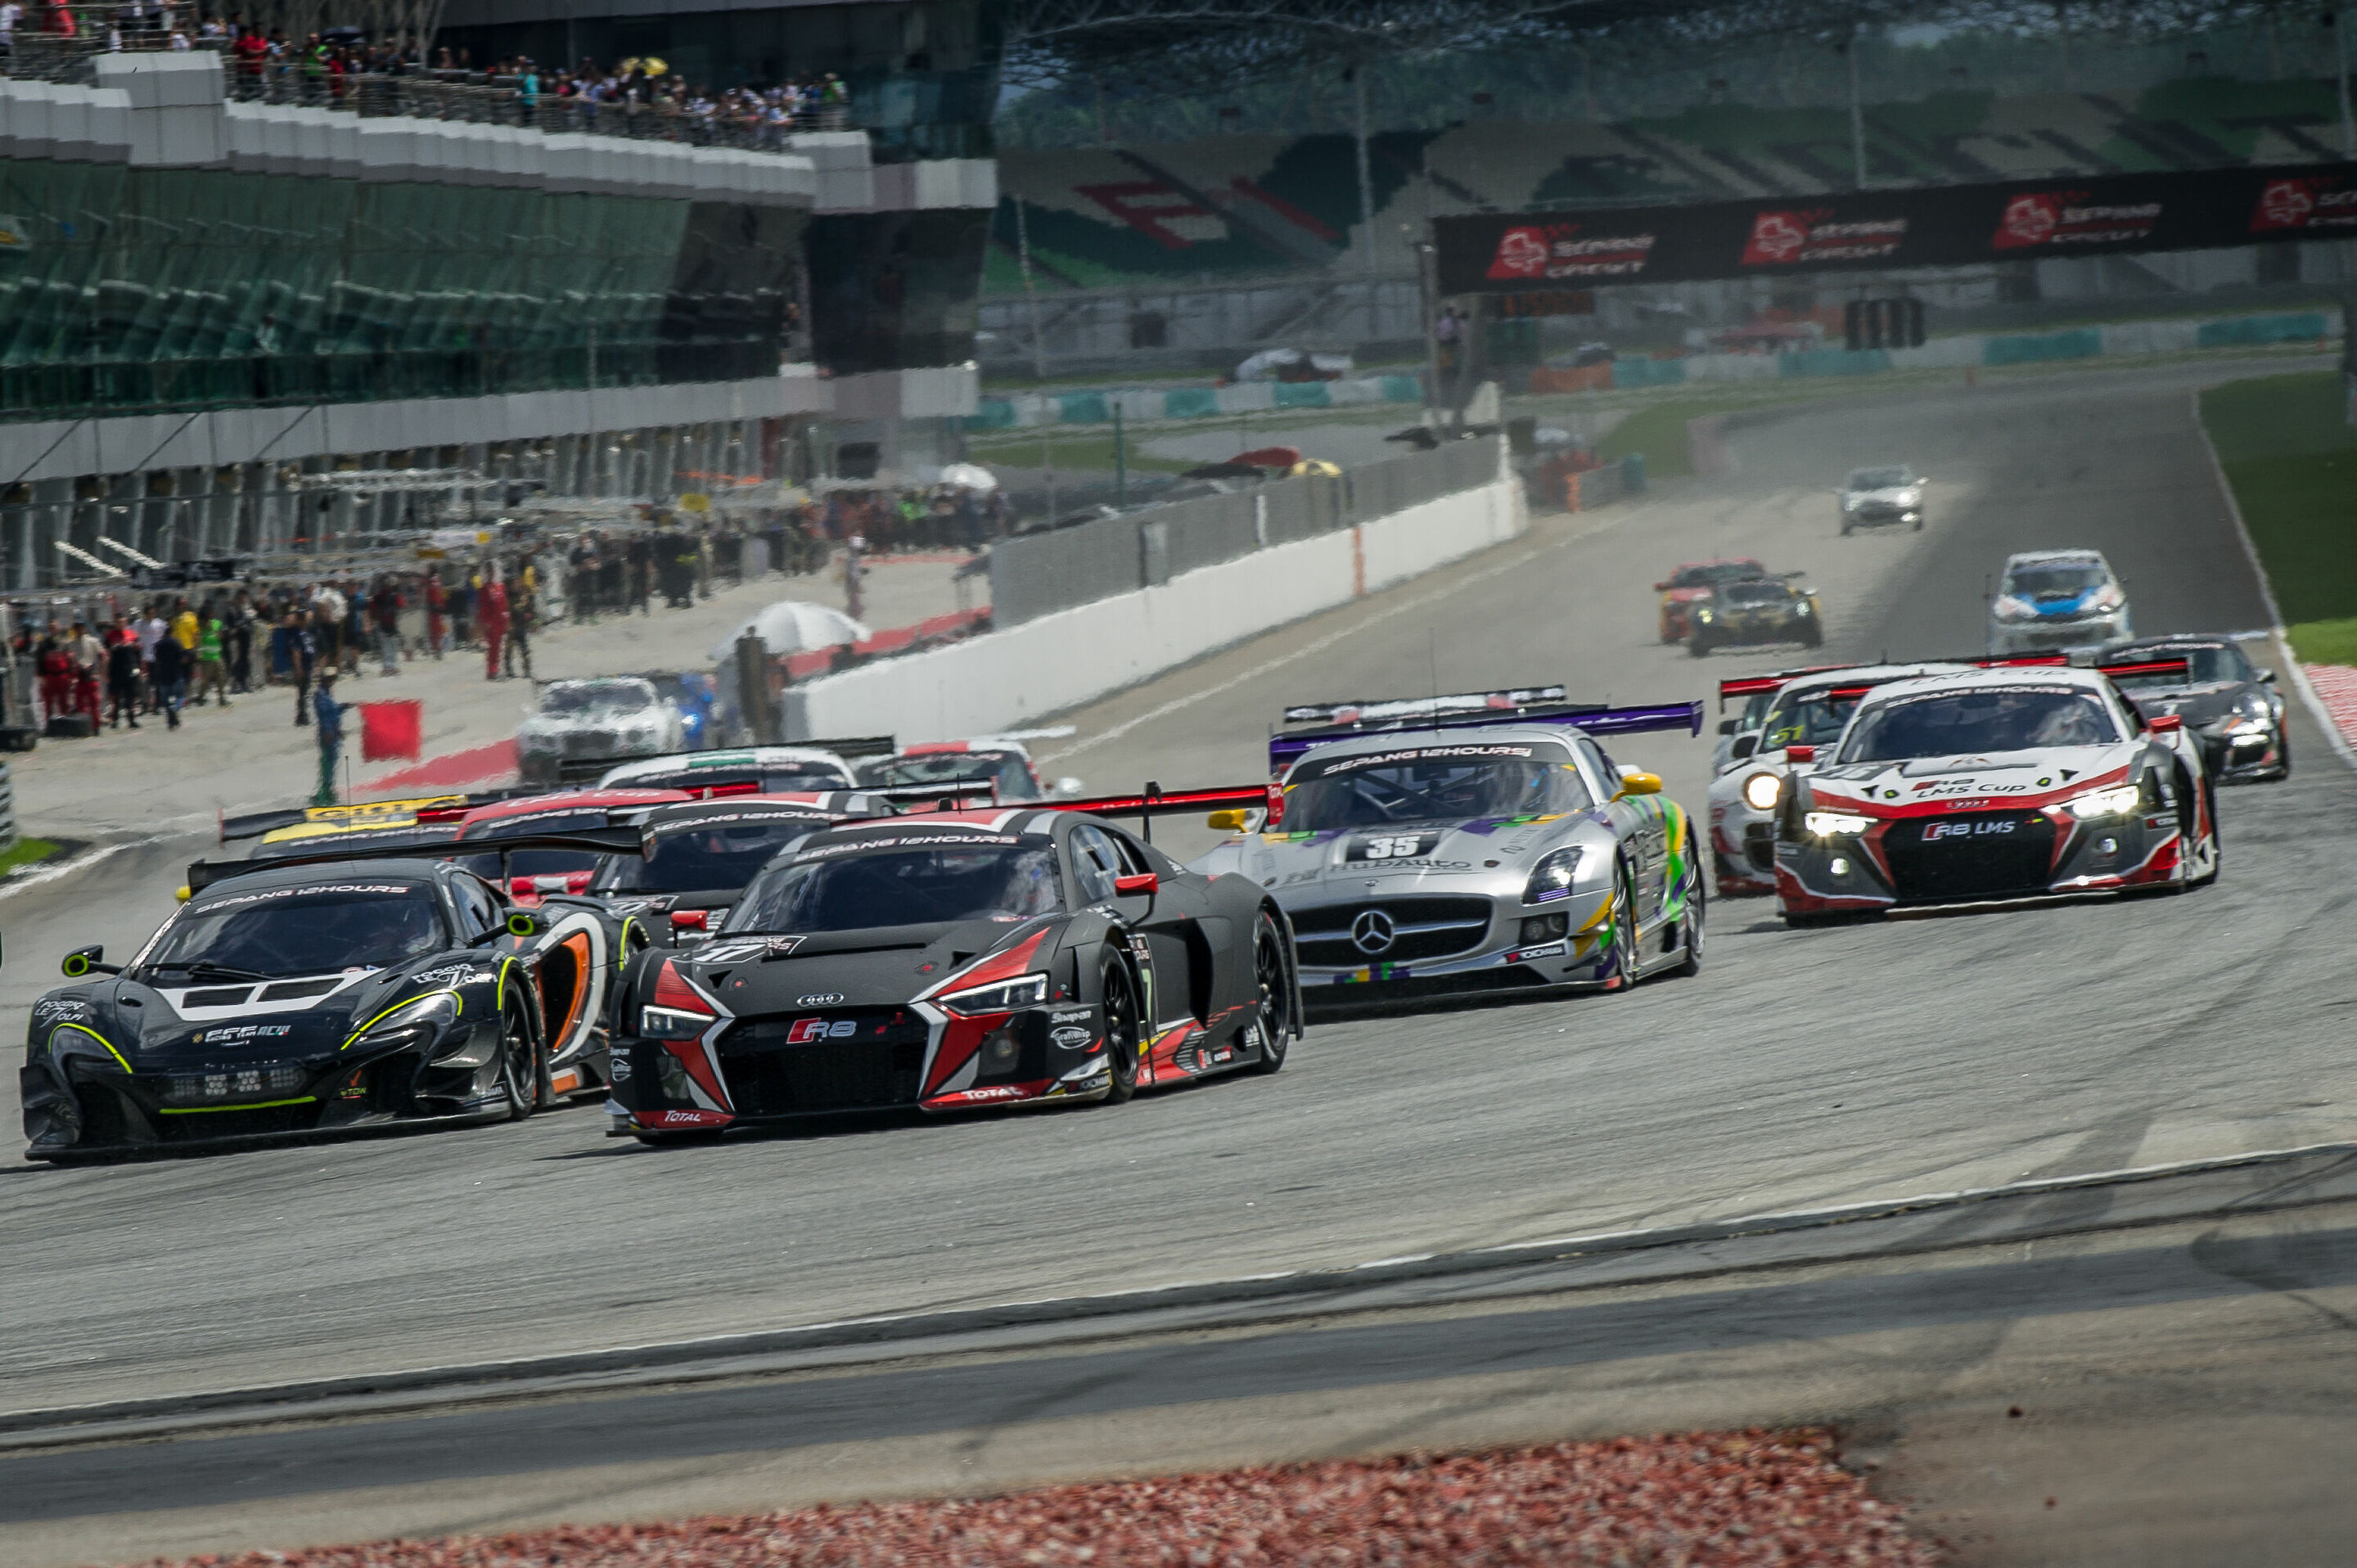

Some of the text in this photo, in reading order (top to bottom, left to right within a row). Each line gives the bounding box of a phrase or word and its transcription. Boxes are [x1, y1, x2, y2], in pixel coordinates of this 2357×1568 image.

[1323, 746, 1532, 776] SEPANG 12HOURS
[1917, 783, 2027, 799] LMS Cup
[1974, 821, 2017, 835] LMS
[793, 835, 1020, 862] SEPANG 12HOURS
[1366, 836, 1422, 860] 35
[195, 885, 411, 914] SEPANG 12HOURS
[798, 1020, 858, 1041] R8
[665, 1110, 701, 1122] TOTAL
